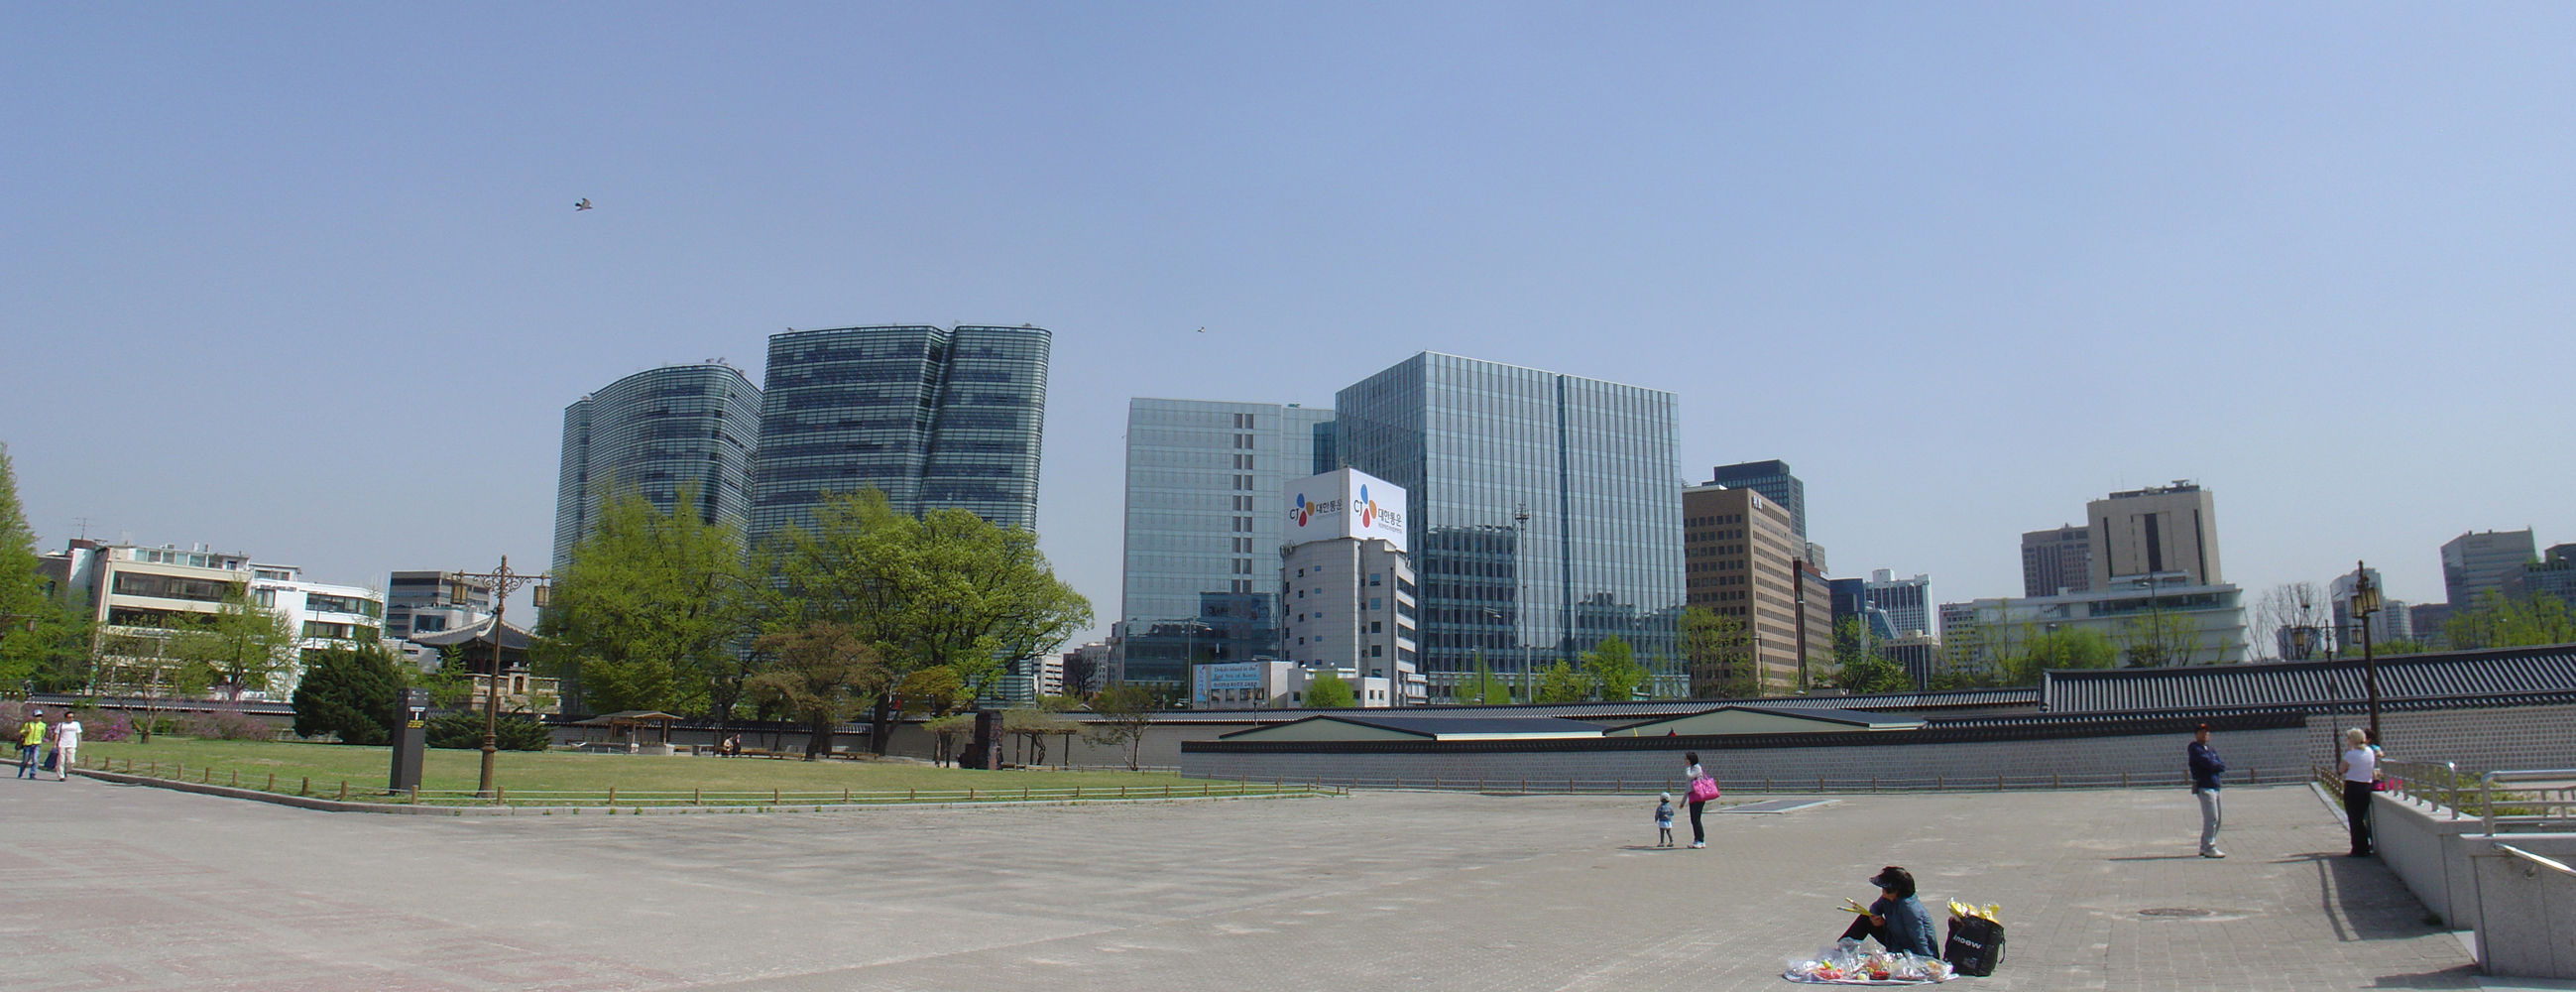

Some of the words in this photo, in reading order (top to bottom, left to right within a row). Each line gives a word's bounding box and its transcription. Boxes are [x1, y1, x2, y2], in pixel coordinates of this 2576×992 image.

[1316, 499, 1343, 513] 대한통운
[1353, 499, 1363, 516] CJ
[1290, 508, 1299, 521] CJ
[1378, 508, 1402, 527] 대한통운
